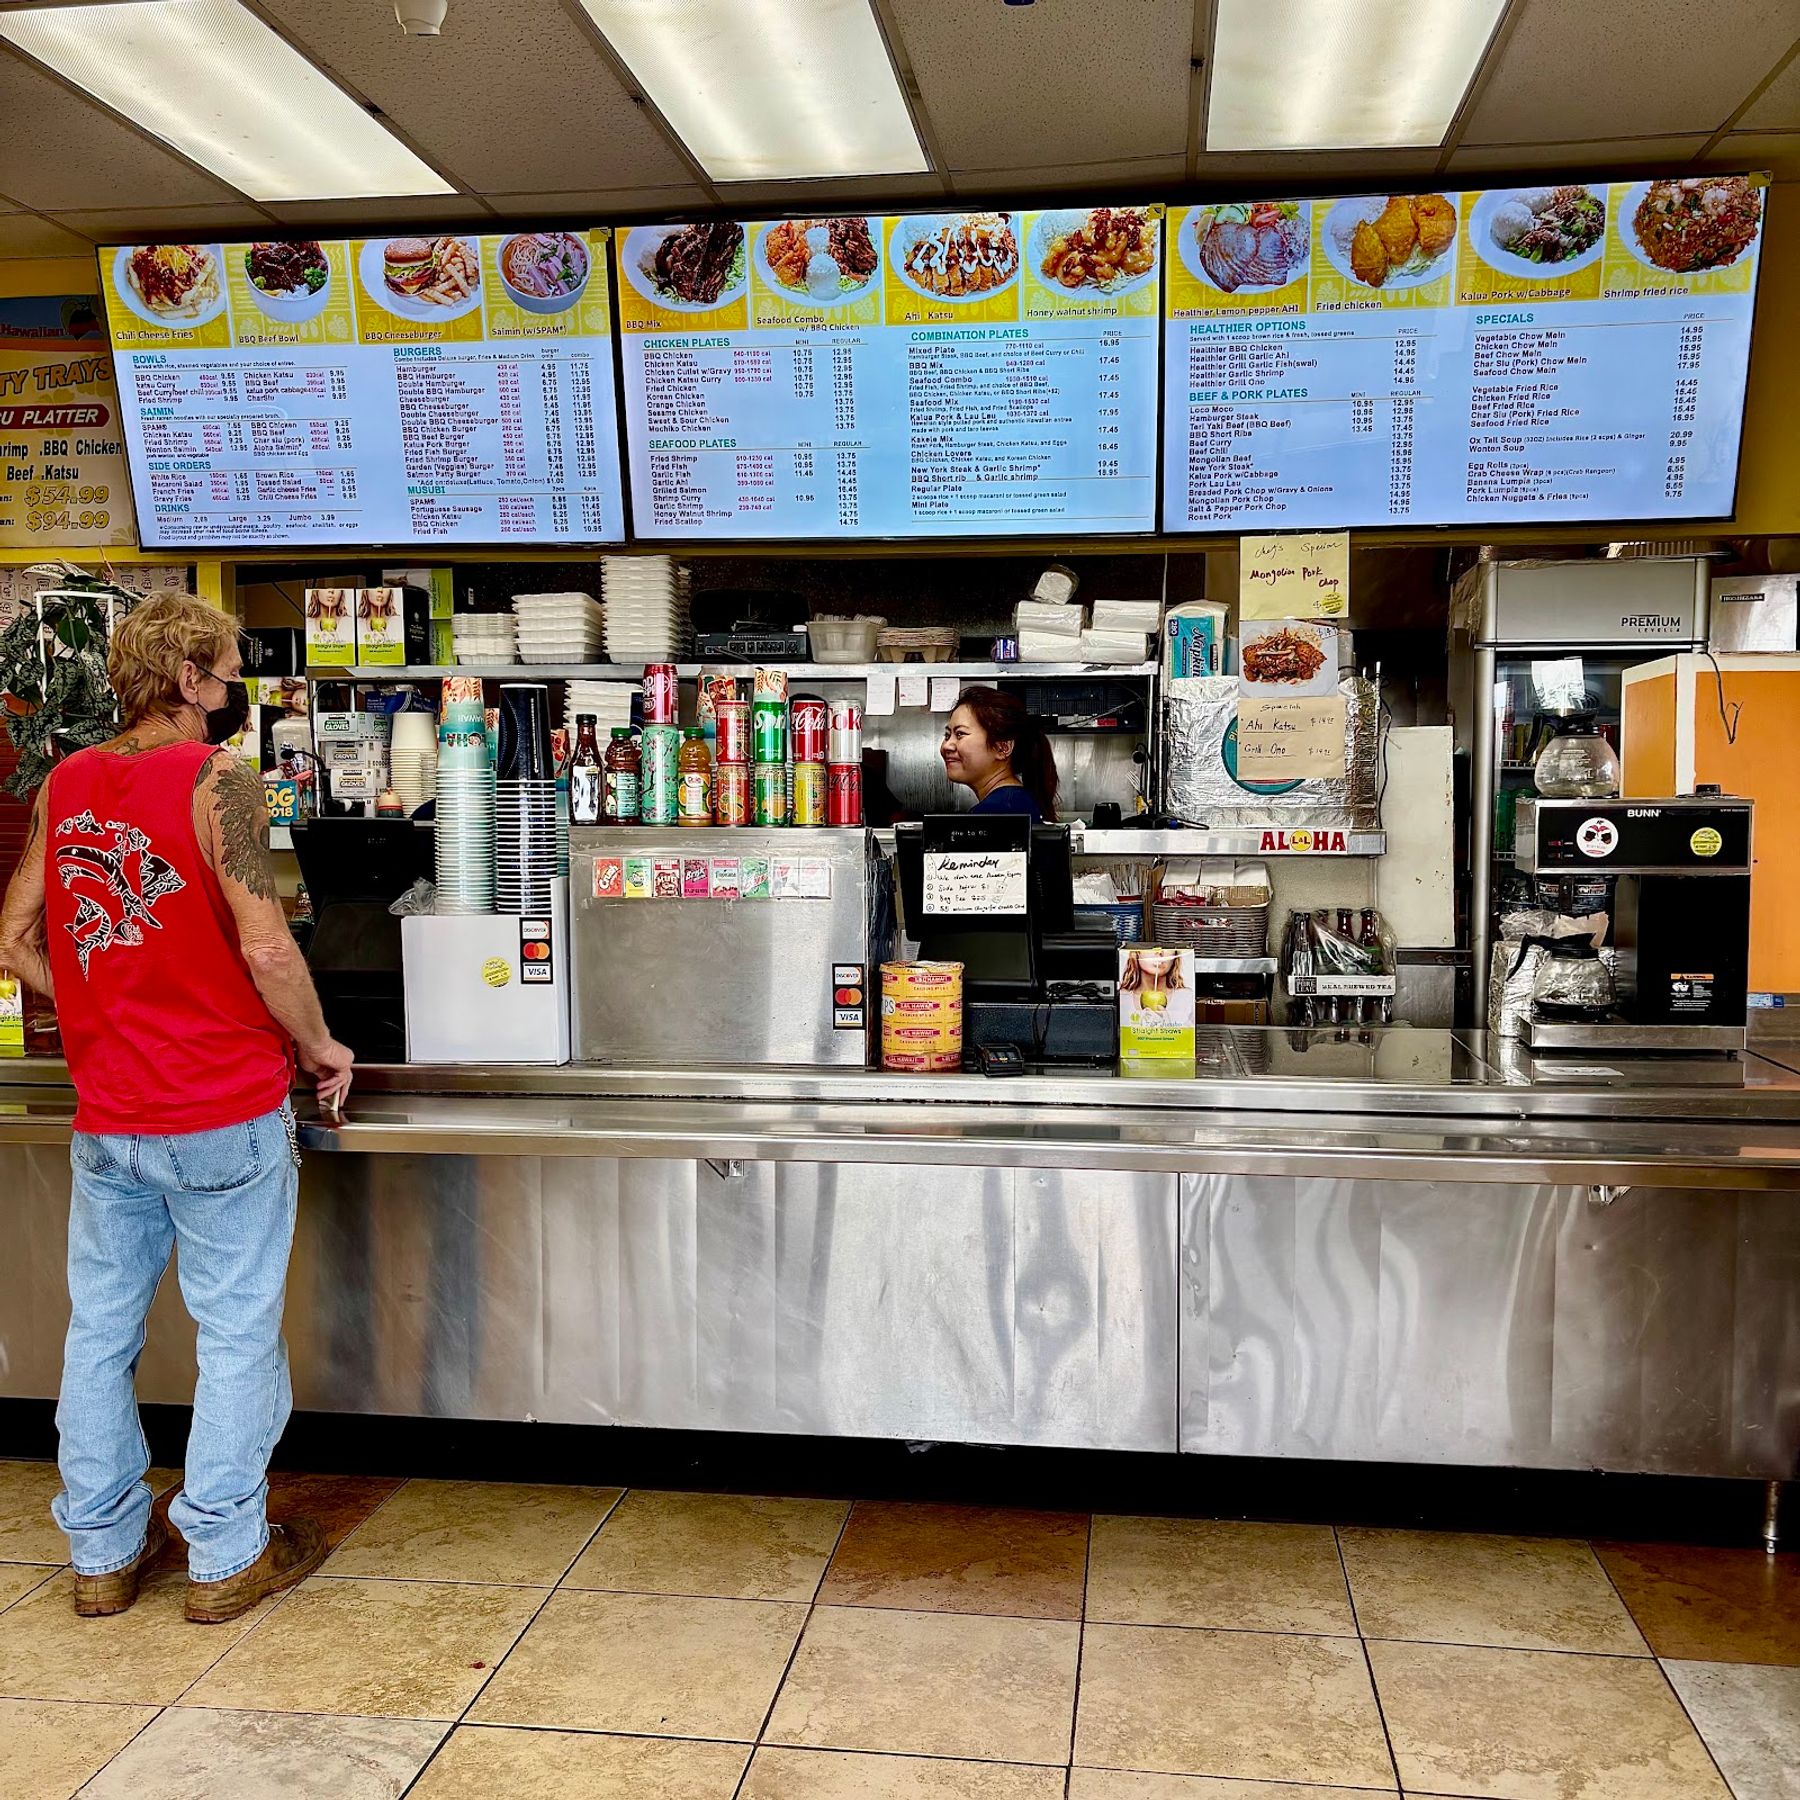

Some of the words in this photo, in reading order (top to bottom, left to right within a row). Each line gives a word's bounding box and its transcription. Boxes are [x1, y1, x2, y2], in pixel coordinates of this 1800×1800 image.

[1460, 291, 1488, 300] Kalua
[1491, 291, 1514, 299] Pork
[1516, 288, 1571, 299] w/Cabbage
[1604, 289, 1640, 299] Shrimp
[1644, 288, 1666, 296] fried
[1316, 302, 1341, 310] Fried
[1344, 301, 1382, 309] chicken
[1027, 309, 1054, 318] Honey
[1088, 307, 1117, 316] shrimp
[1173, 308, 1213, 317] Healthier
[1249, 307, 1280, 315] pepper
[1476, 313, 1533, 324] SPECIALS
[490, 327, 520, 335] Saimin
[1190, 323, 1252, 334] HEALTHIER
[1256, 321, 1306, 331] OPTIONS
[116, 331, 136, 340] Chili
[138, 331, 169, 339] Cheese
[239, 335, 256, 344] BBQ
[365, 333, 383, 341] BBQ
[384, 331, 442, 340] Cheeseburger
[912, 331, 985, 340] COMBINATION
[989, 330, 1028, 339] PLATES
[1476, 333, 1516, 342] Vegetable
[644, 339, 688, 348] CHICKEN
[692, 338, 730, 347] PLATES
[394, 347, 442, 356] BURGERS
[133, 355, 166, 363] BOWLS
[33, 356, 112, 391] TRAYS
[396, 365, 436, 373] Hamburger
[1190, 391, 1218, 401] BEEF
[1221, 391, 1228, 400] &
[1232, 390, 1262, 399] PORK
[1267, 389, 1308, 398] PLATES
[141, 407, 174, 415] SAIMIN
[0, 410, 15, 425] U
[21, 408, 99, 425] PLATTER
[76, 439, 122, 456] Chicken
[649, 440, 696, 448] SEAFOOD
[700, 439, 736, 447] PLATES
[1503, 444, 1524, 453] Soup
[173, 461, 211, 469] ORDERS
[7, 465, 34, 480] Beef
[24, 485, 110, 507] $54.99
[1188, 496, 1229, 505] Mongolian
[1253, 495, 1274, 503] Chop
[155, 504, 189, 512] DRINKS
[25, 510, 111, 532] $94.99
[1302, 566, 1323, 580] Pork
[1622, 617, 1680, 626] PREMIUM
[938, 856, 1000, 870] Reminder
